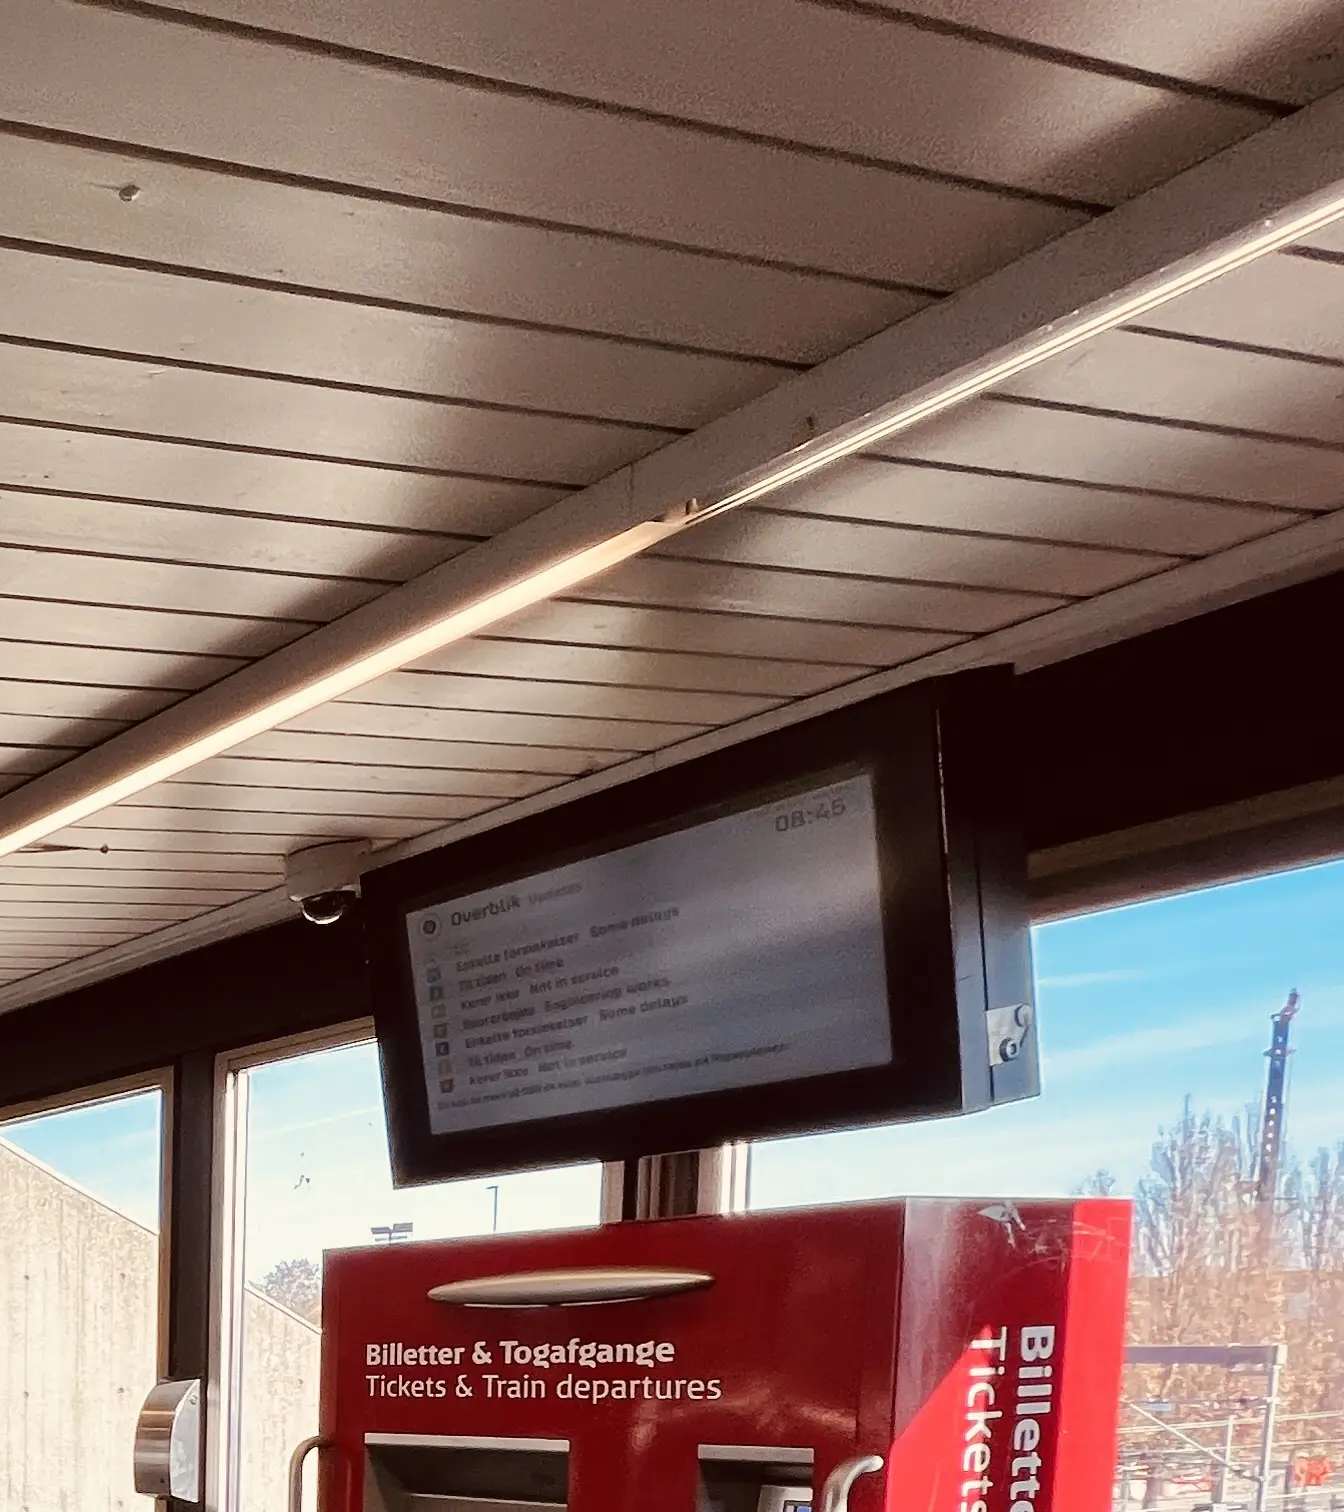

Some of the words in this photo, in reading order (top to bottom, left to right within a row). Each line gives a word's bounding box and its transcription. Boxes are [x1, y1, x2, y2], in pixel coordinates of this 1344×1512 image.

[776, 800, 846, 832] 08:45
[451, 895, 521, 928] Overblik
[366, 1342, 465, 1366] Billetter
[471, 1341, 493, 1365] &
[499, 1338, 675, 1368] Togafgange
[365, 1374, 447, 1398] Tickets
[454, 1374, 474, 1398] &
[482, 1374, 547, 1400] Train
[556, 1373, 723, 1405] departures
